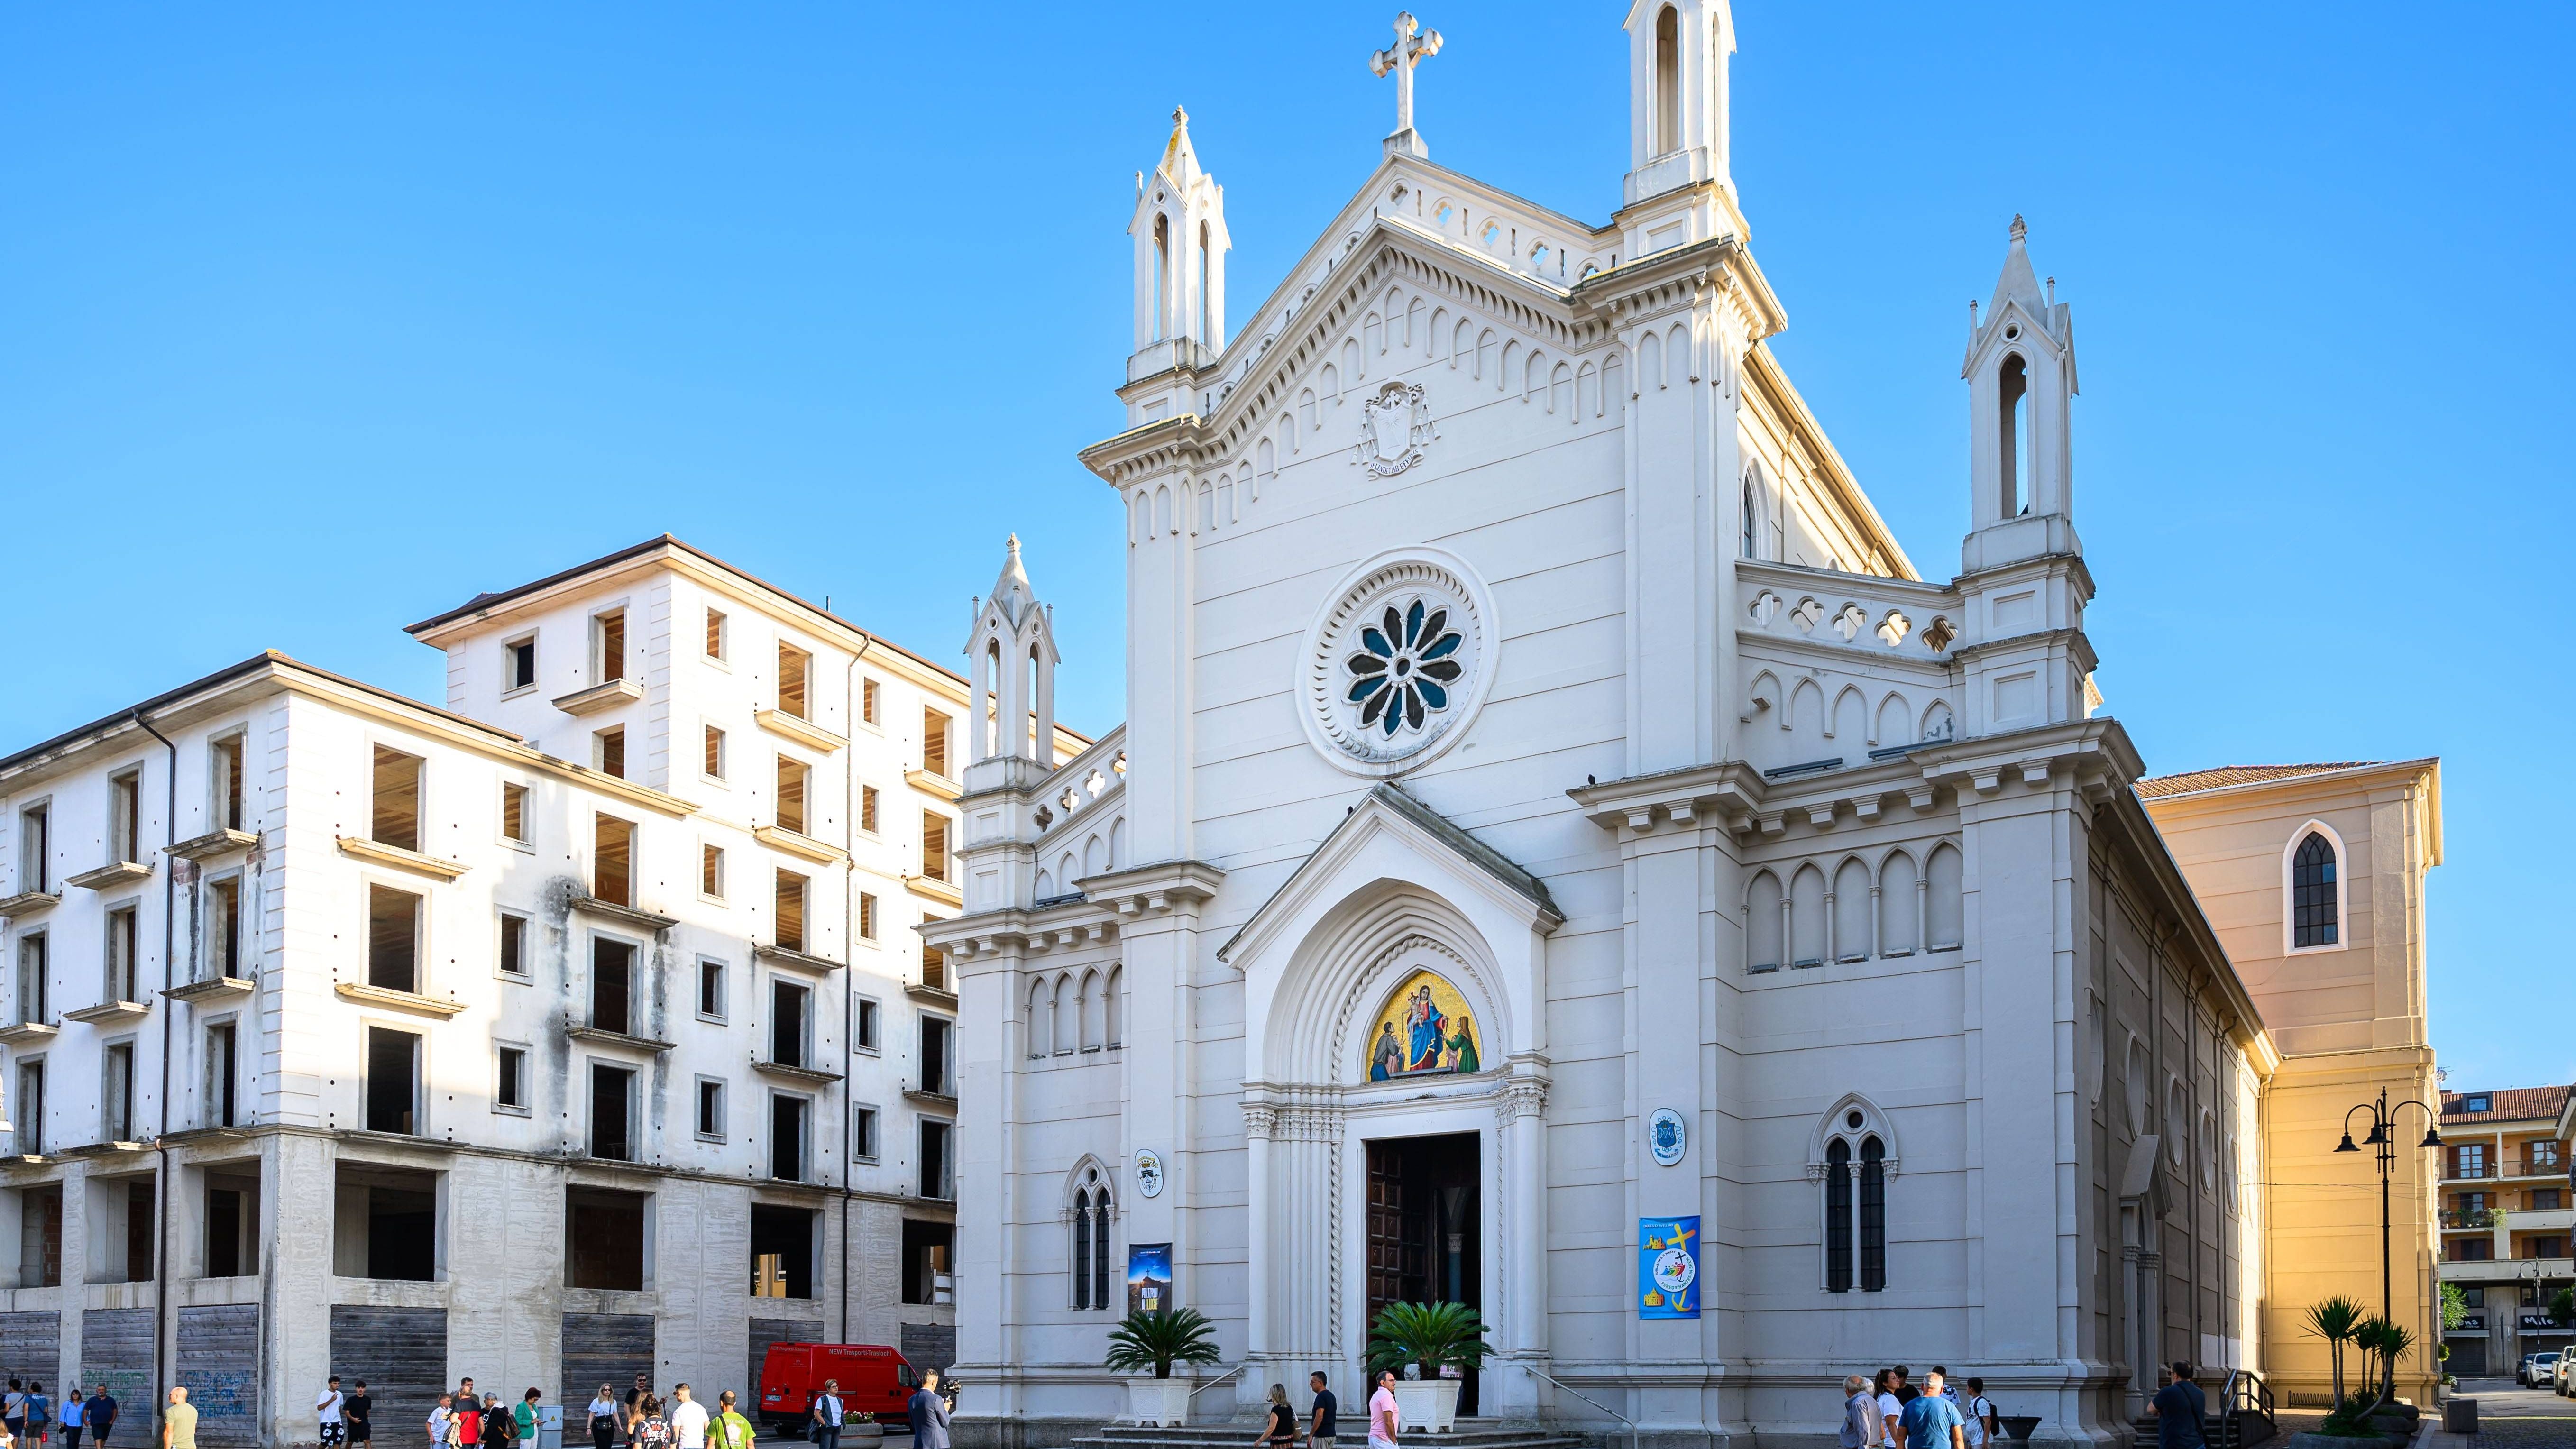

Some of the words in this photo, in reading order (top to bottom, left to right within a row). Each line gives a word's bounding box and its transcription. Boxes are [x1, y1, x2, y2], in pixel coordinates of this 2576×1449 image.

[1661, 1275, 1692, 1290] PEREGRINANTES
[1685, 1257, 1693, 1269] SPEM
[1142, 1299, 1146, 1310] DI
[1146, 1298, 1158, 1310] LUCE
